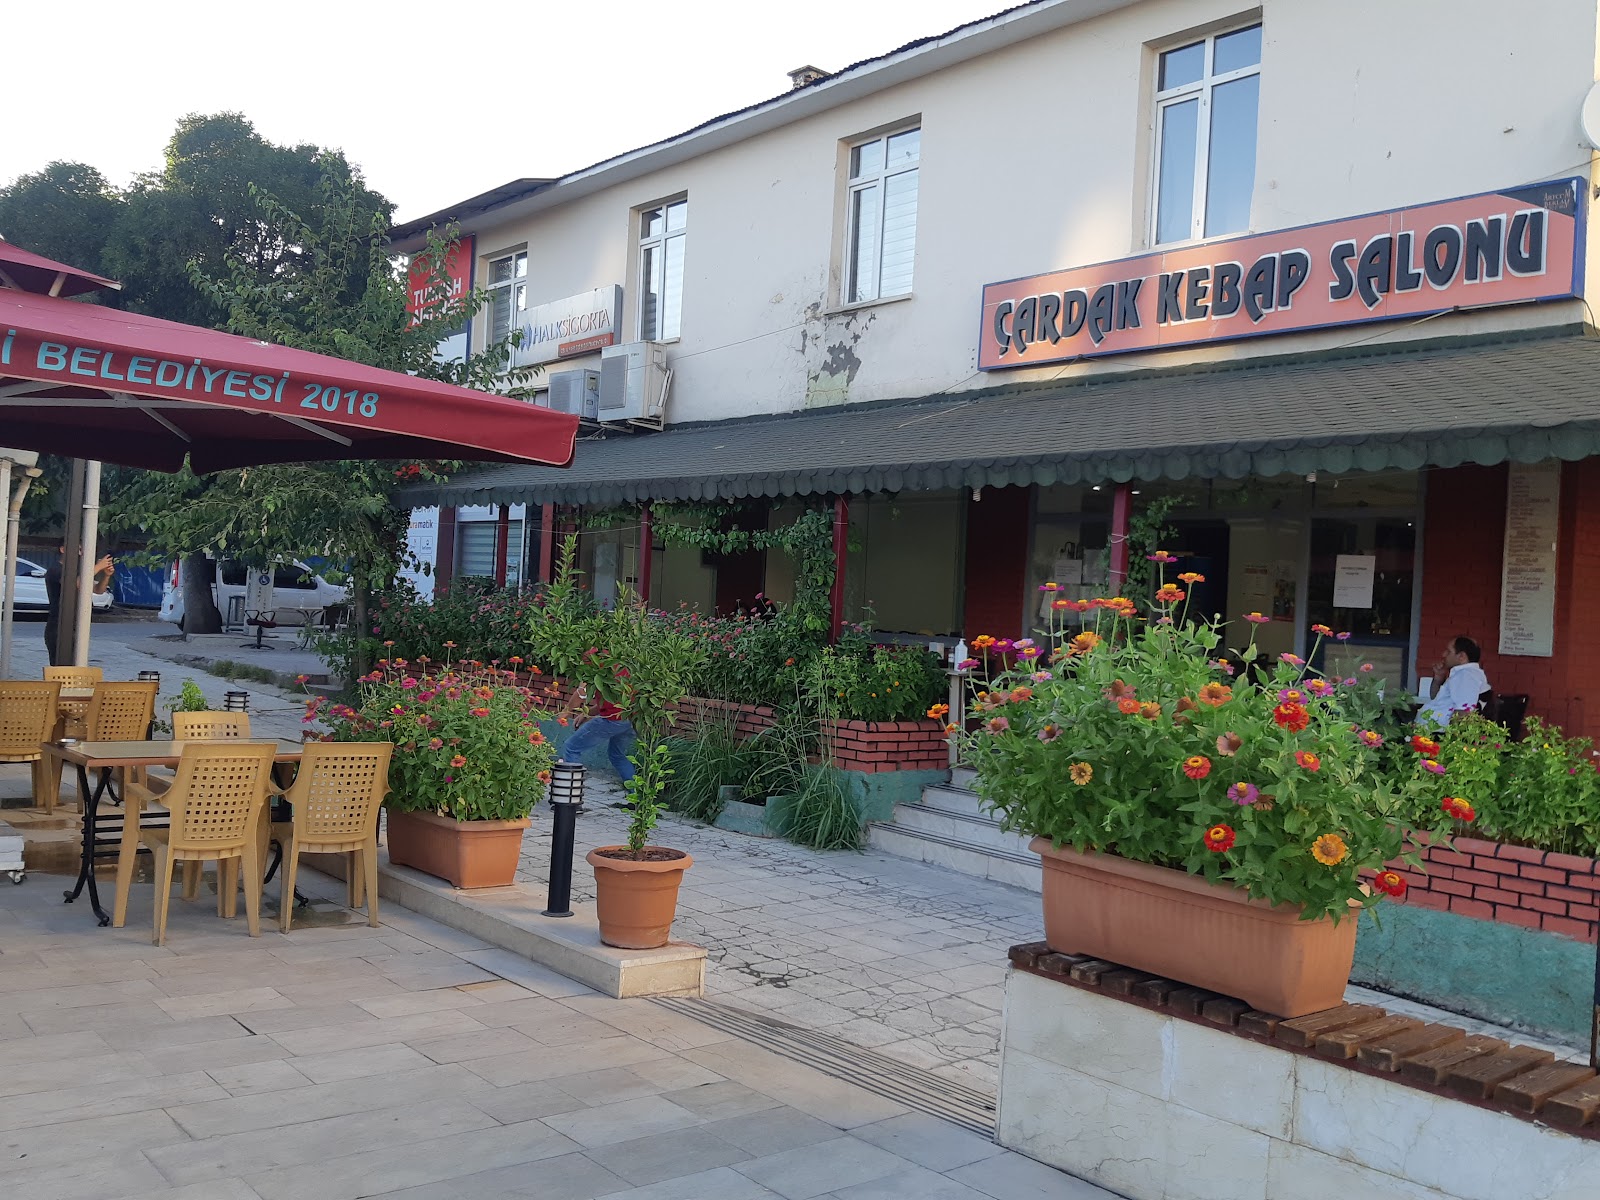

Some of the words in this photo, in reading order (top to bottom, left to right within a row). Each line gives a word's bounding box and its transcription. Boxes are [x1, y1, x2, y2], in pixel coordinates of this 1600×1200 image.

[413, 277, 462, 307] TUISH
[1157, 248, 1311, 325] KEBAP
[1329, 208, 1549, 311] SALONU
[36, 341, 290, 403] BELEDİYESİ
[299, 383, 380, 418] 2018
